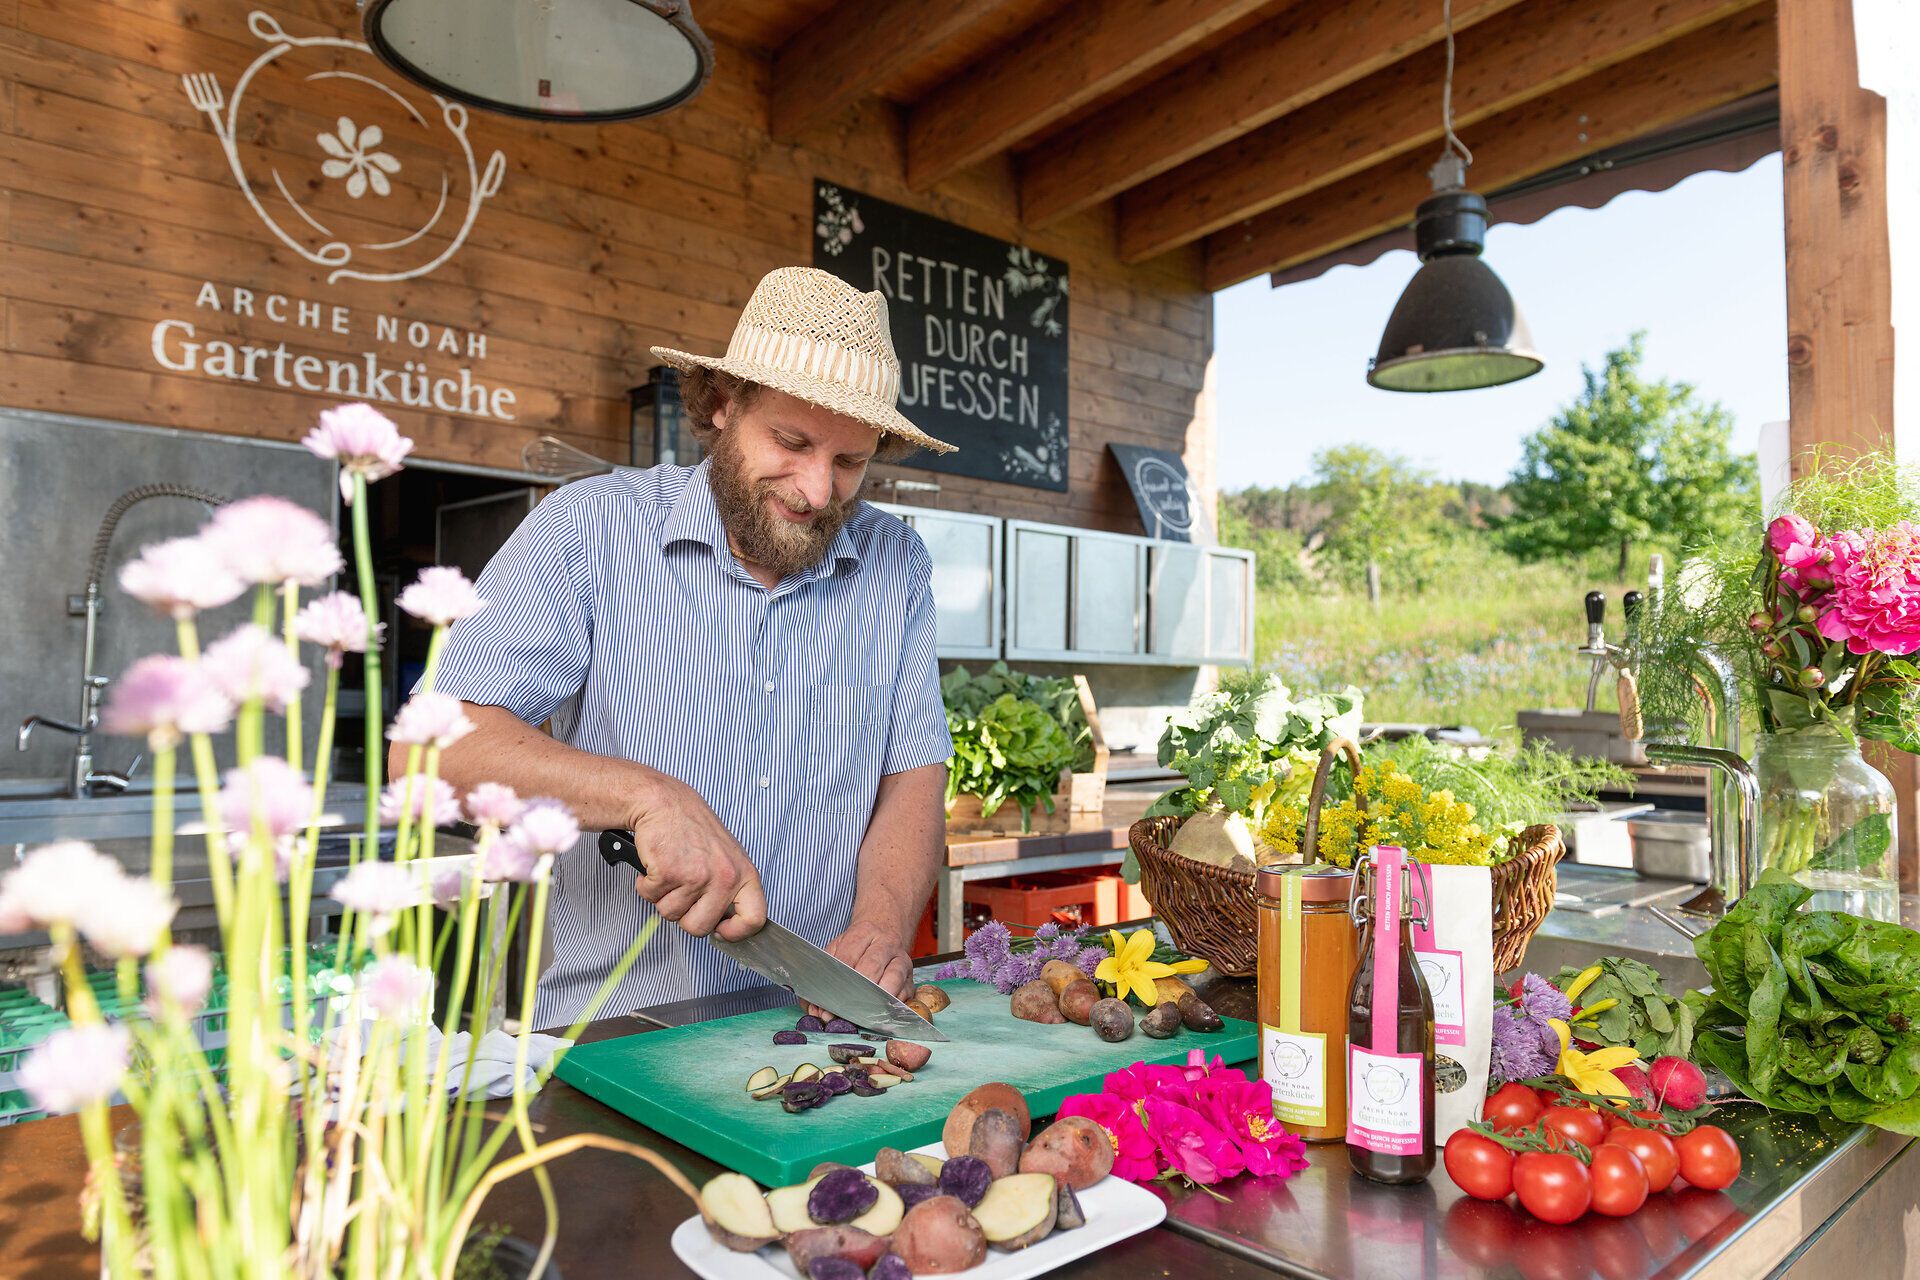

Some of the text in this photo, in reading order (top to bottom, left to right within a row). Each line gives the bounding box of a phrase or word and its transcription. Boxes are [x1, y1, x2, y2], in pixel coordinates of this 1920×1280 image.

[871, 245, 1005, 320] RETTEN
[195, 281, 487, 359] ARCHE NOAH
[925, 314, 1028, 377] DURCH
[150, 318, 517, 421] Gartenküche
[899, 362, 1039, 430] UFESSEN
[1271, 1078, 1289, 1088] ARCHE
[1272, 1086, 1315, 1100] artenküche
[1295, 1108, 1320, 1117] AUFESSEN
[1358, 1110, 1413, 1127] Gartenküche
[1363, 1105, 1384, 1115] ARCHE
[1354, 1128, 1417, 1145] RETTEN DURCH AUFESSEN
[1367, 1140, 1384, 1149] Vielfalt
[1392, 1143, 1403, 1151] Glas
